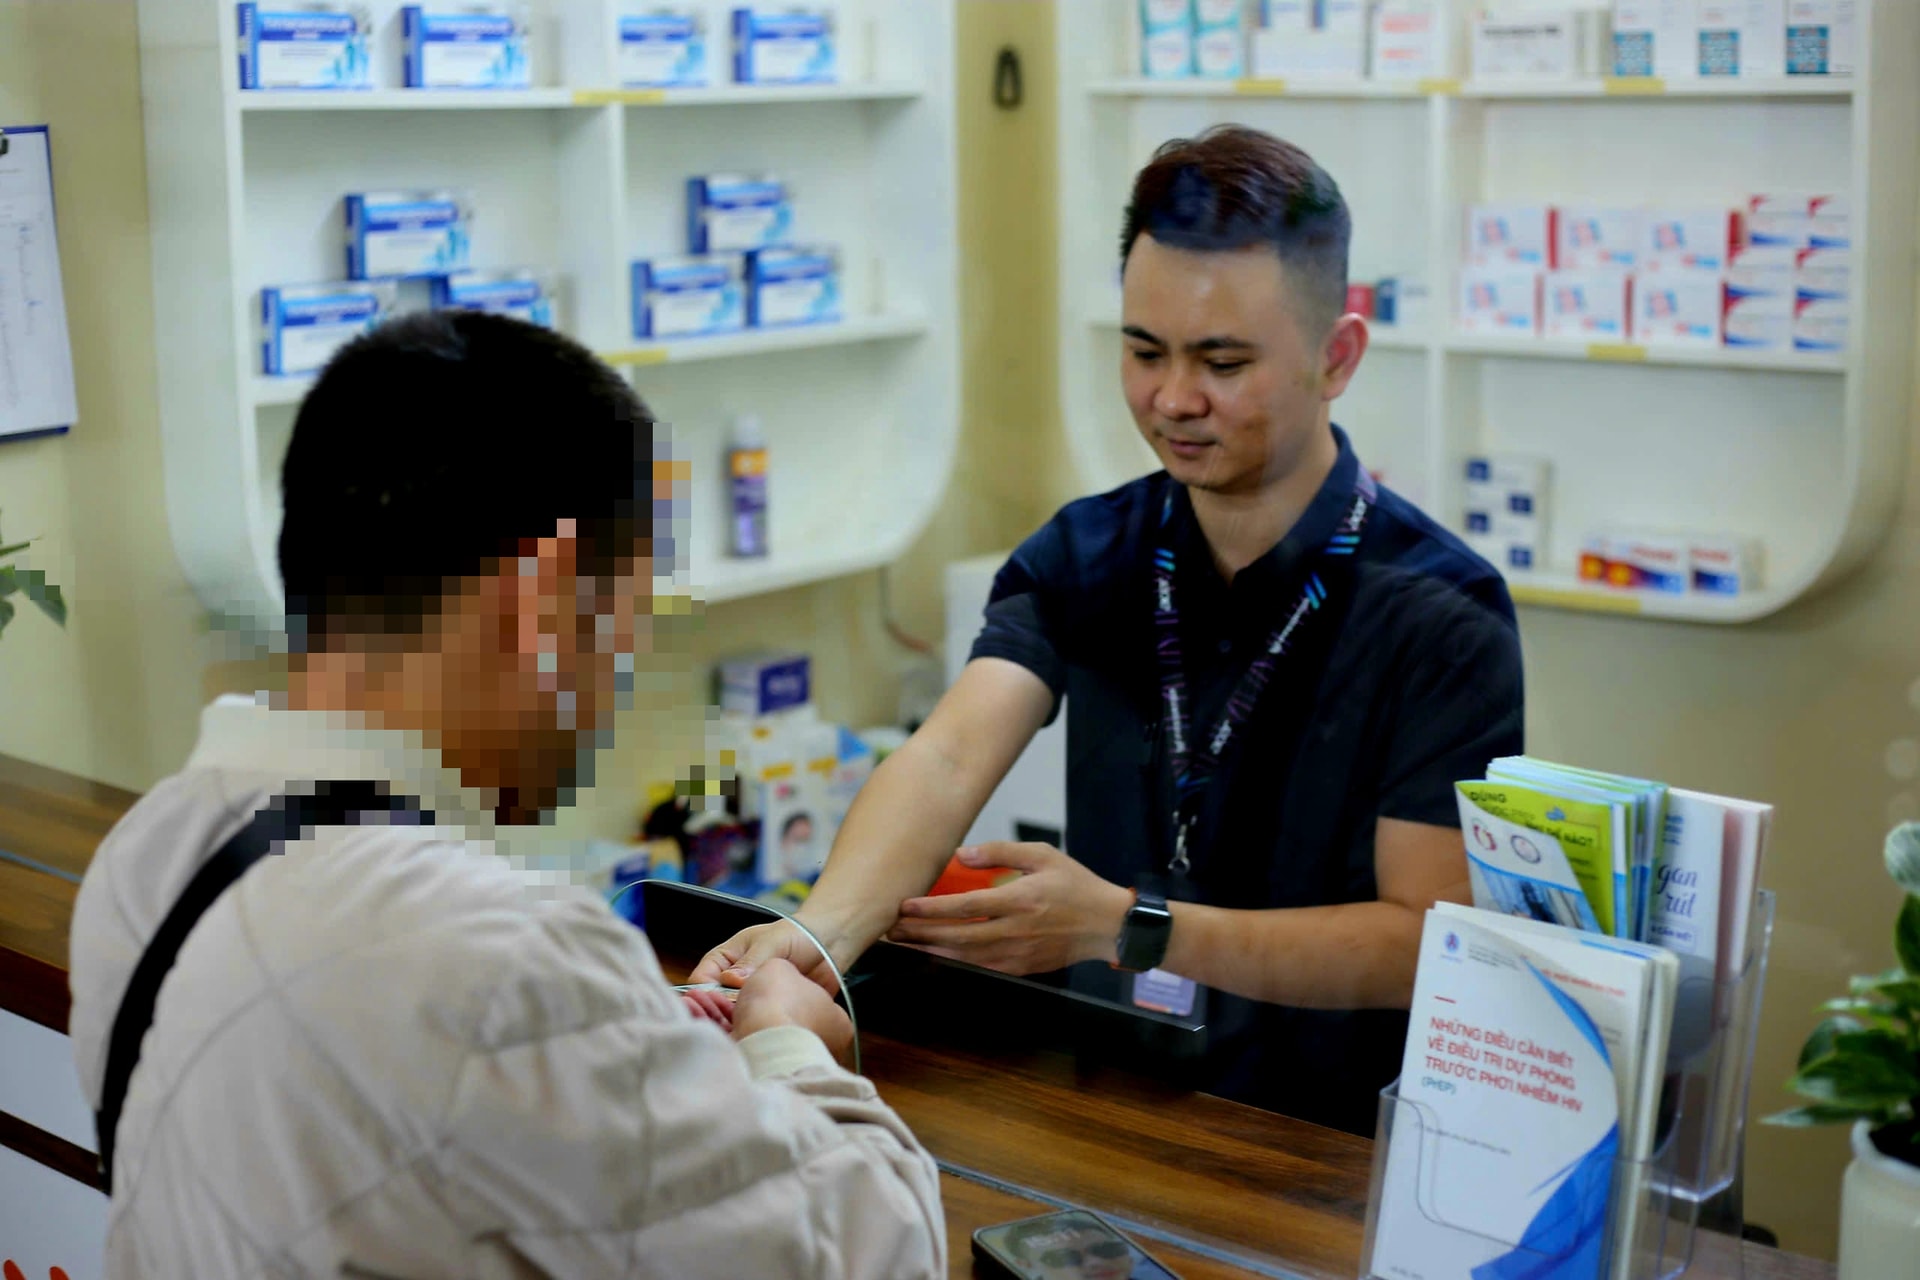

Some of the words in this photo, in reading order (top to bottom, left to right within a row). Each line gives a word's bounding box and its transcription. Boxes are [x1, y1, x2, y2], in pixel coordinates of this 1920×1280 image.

[1425, 1055, 1477, 1081] TRƯỚC
[1427, 1034, 1444, 1052] VỀ
[1447, 1041, 1480, 1061] ĐIỀU
[1529, 1063, 1575, 1091] PHÒNG
[1429, 1016, 1482, 1041] NHỮNG
[1484, 1028, 1514, 1051] ĐIỀU
[1517, 1039, 1544, 1060] CẦN
[1546, 1049, 1574, 1070] BIẾT
